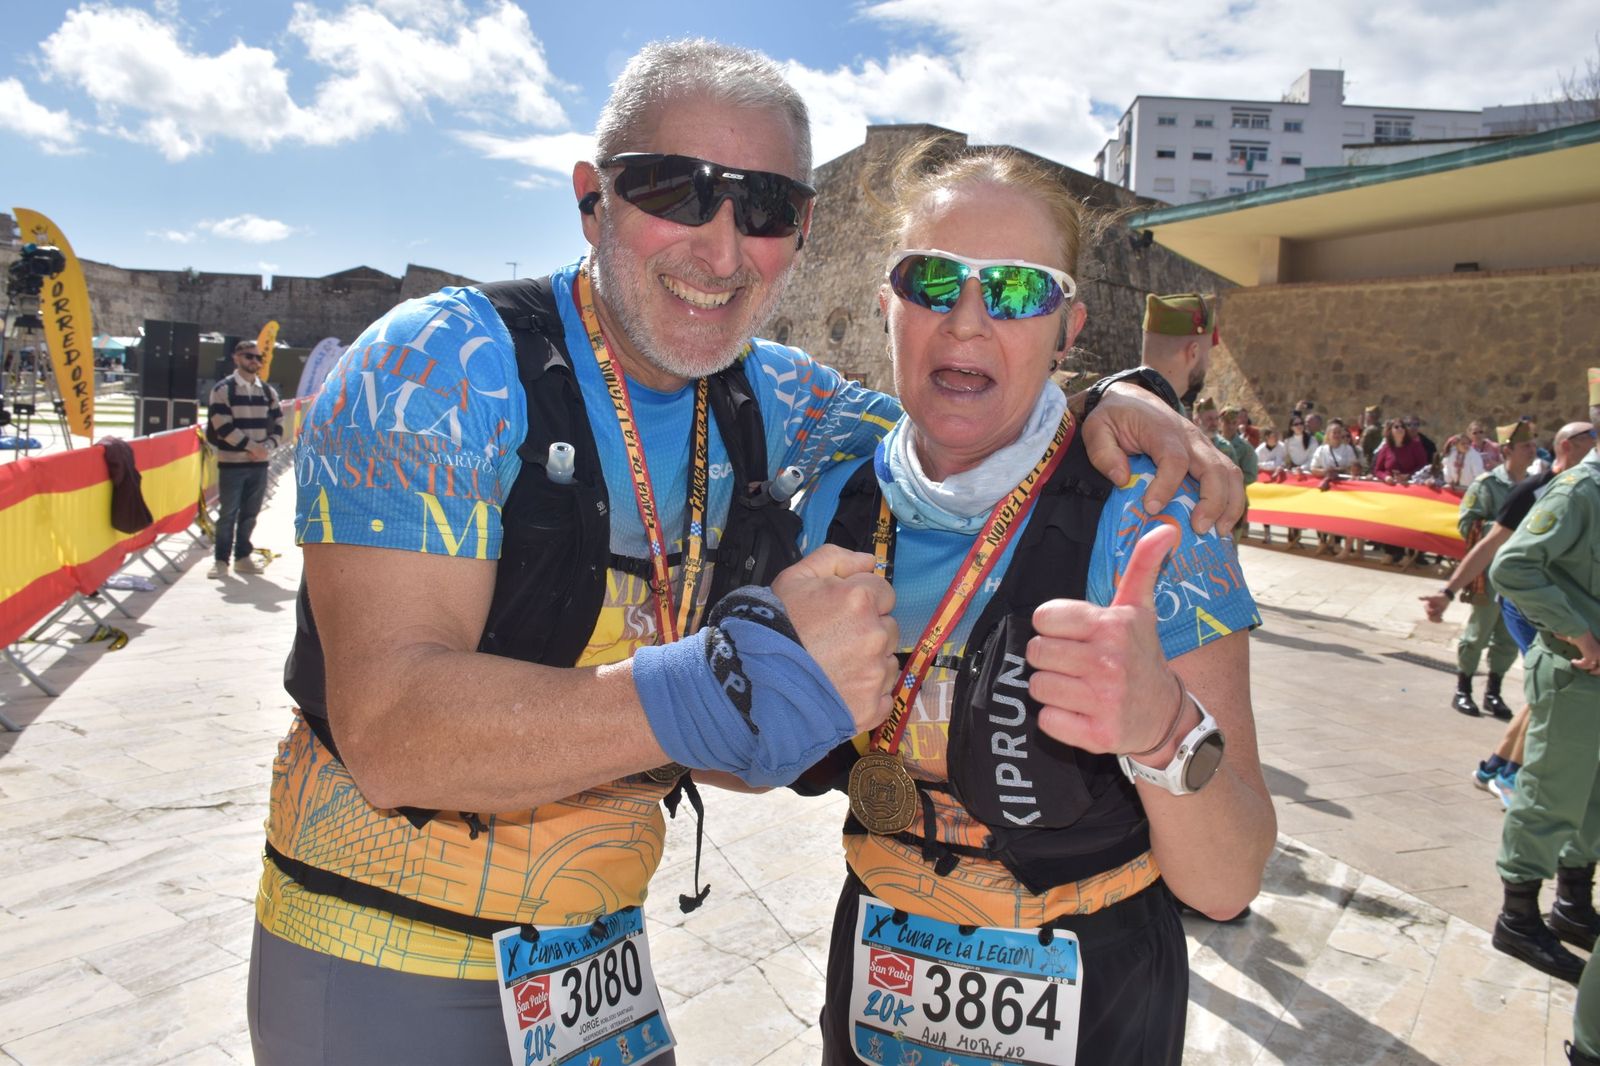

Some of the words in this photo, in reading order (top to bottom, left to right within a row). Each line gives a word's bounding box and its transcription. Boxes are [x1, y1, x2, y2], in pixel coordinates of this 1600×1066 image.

[51, 271, 92, 430] ORREDORES
[988, 652, 1041, 826] KIPRUN
[868, 914, 891, 938] X
[508, 942, 520, 977] X
[869, 960, 888, 976] San
[888, 966, 913, 982] Pablo
[561, 940, 643, 1028] 3080
[517, 1000, 530, 1014] San
[529, 992, 549, 1007] Pablo
[863, 989, 915, 1027] 20K
[922, 965, 1061, 1041] 3864
[579, 1017, 600, 1035] JORGE
[921, 1027, 947, 1046] ANA
[957, 1034, 1025, 1058] MORENO
